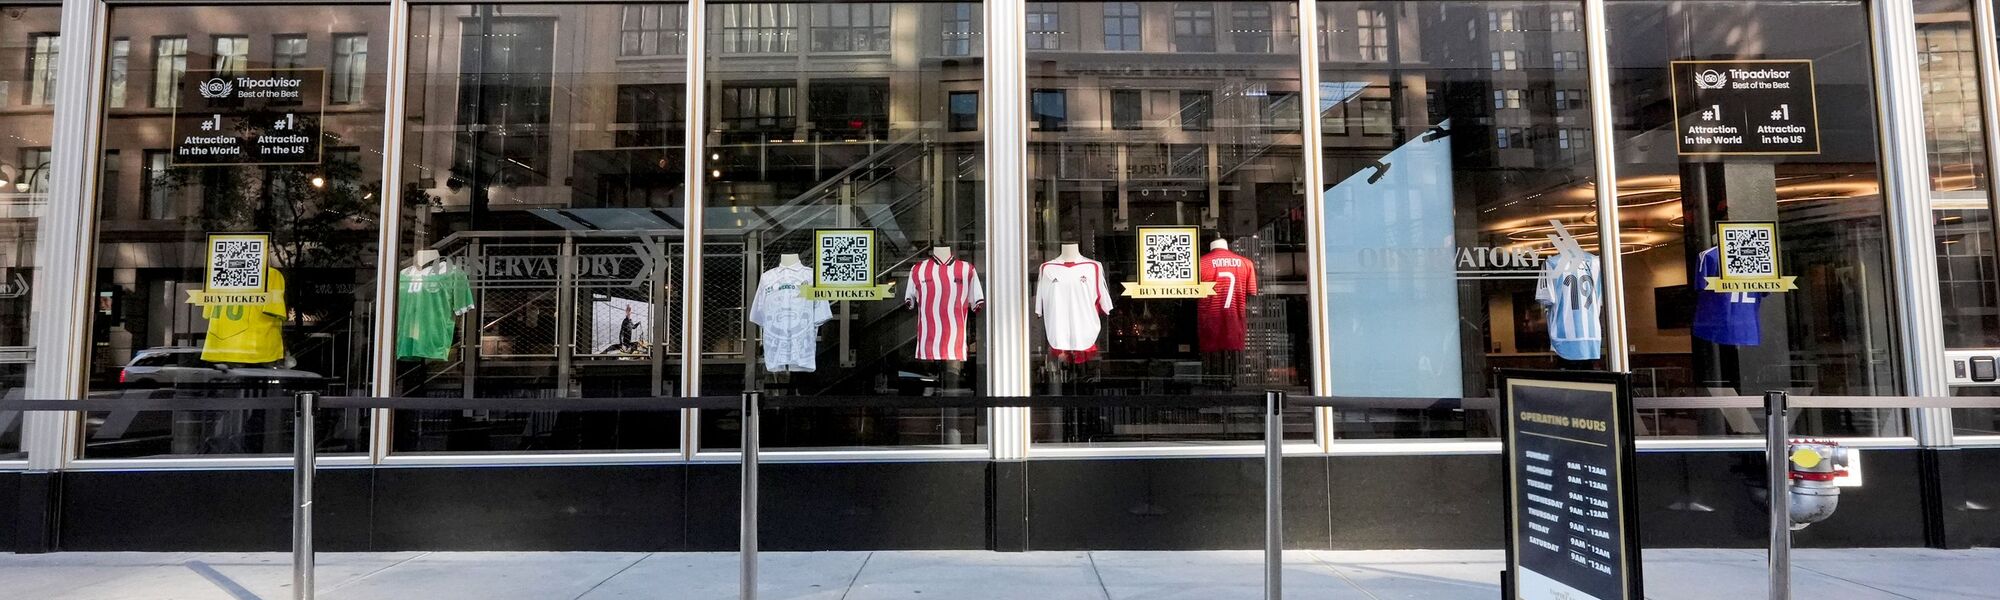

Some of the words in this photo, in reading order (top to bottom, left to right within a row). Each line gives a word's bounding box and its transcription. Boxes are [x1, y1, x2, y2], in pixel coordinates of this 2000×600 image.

[1729, 69, 1791, 80] Tripadvisor
[237, 77, 302, 89] Tripadvisor
[238, 90, 256, 98] Best
[257, 90, 266, 98] of
[266, 90, 280, 98] the
[281, 90, 299, 98] Best
[1702, 104, 1720, 121] #1
[1770, 104, 1790, 121] #1
[201, 114, 221, 131] #1
[274, 113, 294, 130] #1
[1688, 126, 1738, 134] Attraction
[1757, 125, 1806, 133] Attraction
[184, 135, 236, 144] Attraction
[257, 135, 309, 144] Attraction
[1685, 136, 1695, 145] in
[1695, 136, 1712, 145] the
[1713, 136, 1742, 145] World
[1762, 135, 1772, 144] in
[1772, 135, 1789, 144] the
[1790, 135, 1803, 144] US
[179, 146, 190, 155] in
[191, 146, 208, 155] the
[209, 146, 240, 155] World
[261, 145, 272, 154] in
[273, 145, 290, 154] the
[291, 145, 305, 154] US
[1212, 258, 1242, 269] RONALDO
[1218, 271, 1236, 309] 7
[1722, 282, 1741, 290] BUY
[1741, 281, 1781, 289] TICKETS
[814, 290, 834, 298] BUY
[836, 290, 875, 298] TICKETS
[1562, 274, 1594, 310] 19
[225, 295, 266, 303] TICKETS
[1520, 411, 1570, 427] OPERATING
[1571, 418, 1607, 432] HOURS
[1566, 462, 1581, 470] 9AM
[1526, 464, 1553, 477] MONDAY
[1567, 476, 1582, 485] 9AM
[1527, 479, 1553, 491] TUESDAY
[1568, 492, 1583, 502] 9AM
[1527, 493, 1564, 509] WEDNESDAY
[1569, 506, 1583, 516] 9AM
[1528, 507, 1559, 522] THURSDAY
[1569, 522, 1585, 533] 9AM
[1528, 521, 1550, 534] FRIDAY
[1570, 537, 1586, 549] 9AM
[1529, 536, 1559, 552] SATURDAY
[1570, 552, 1586, 565] 9AM
